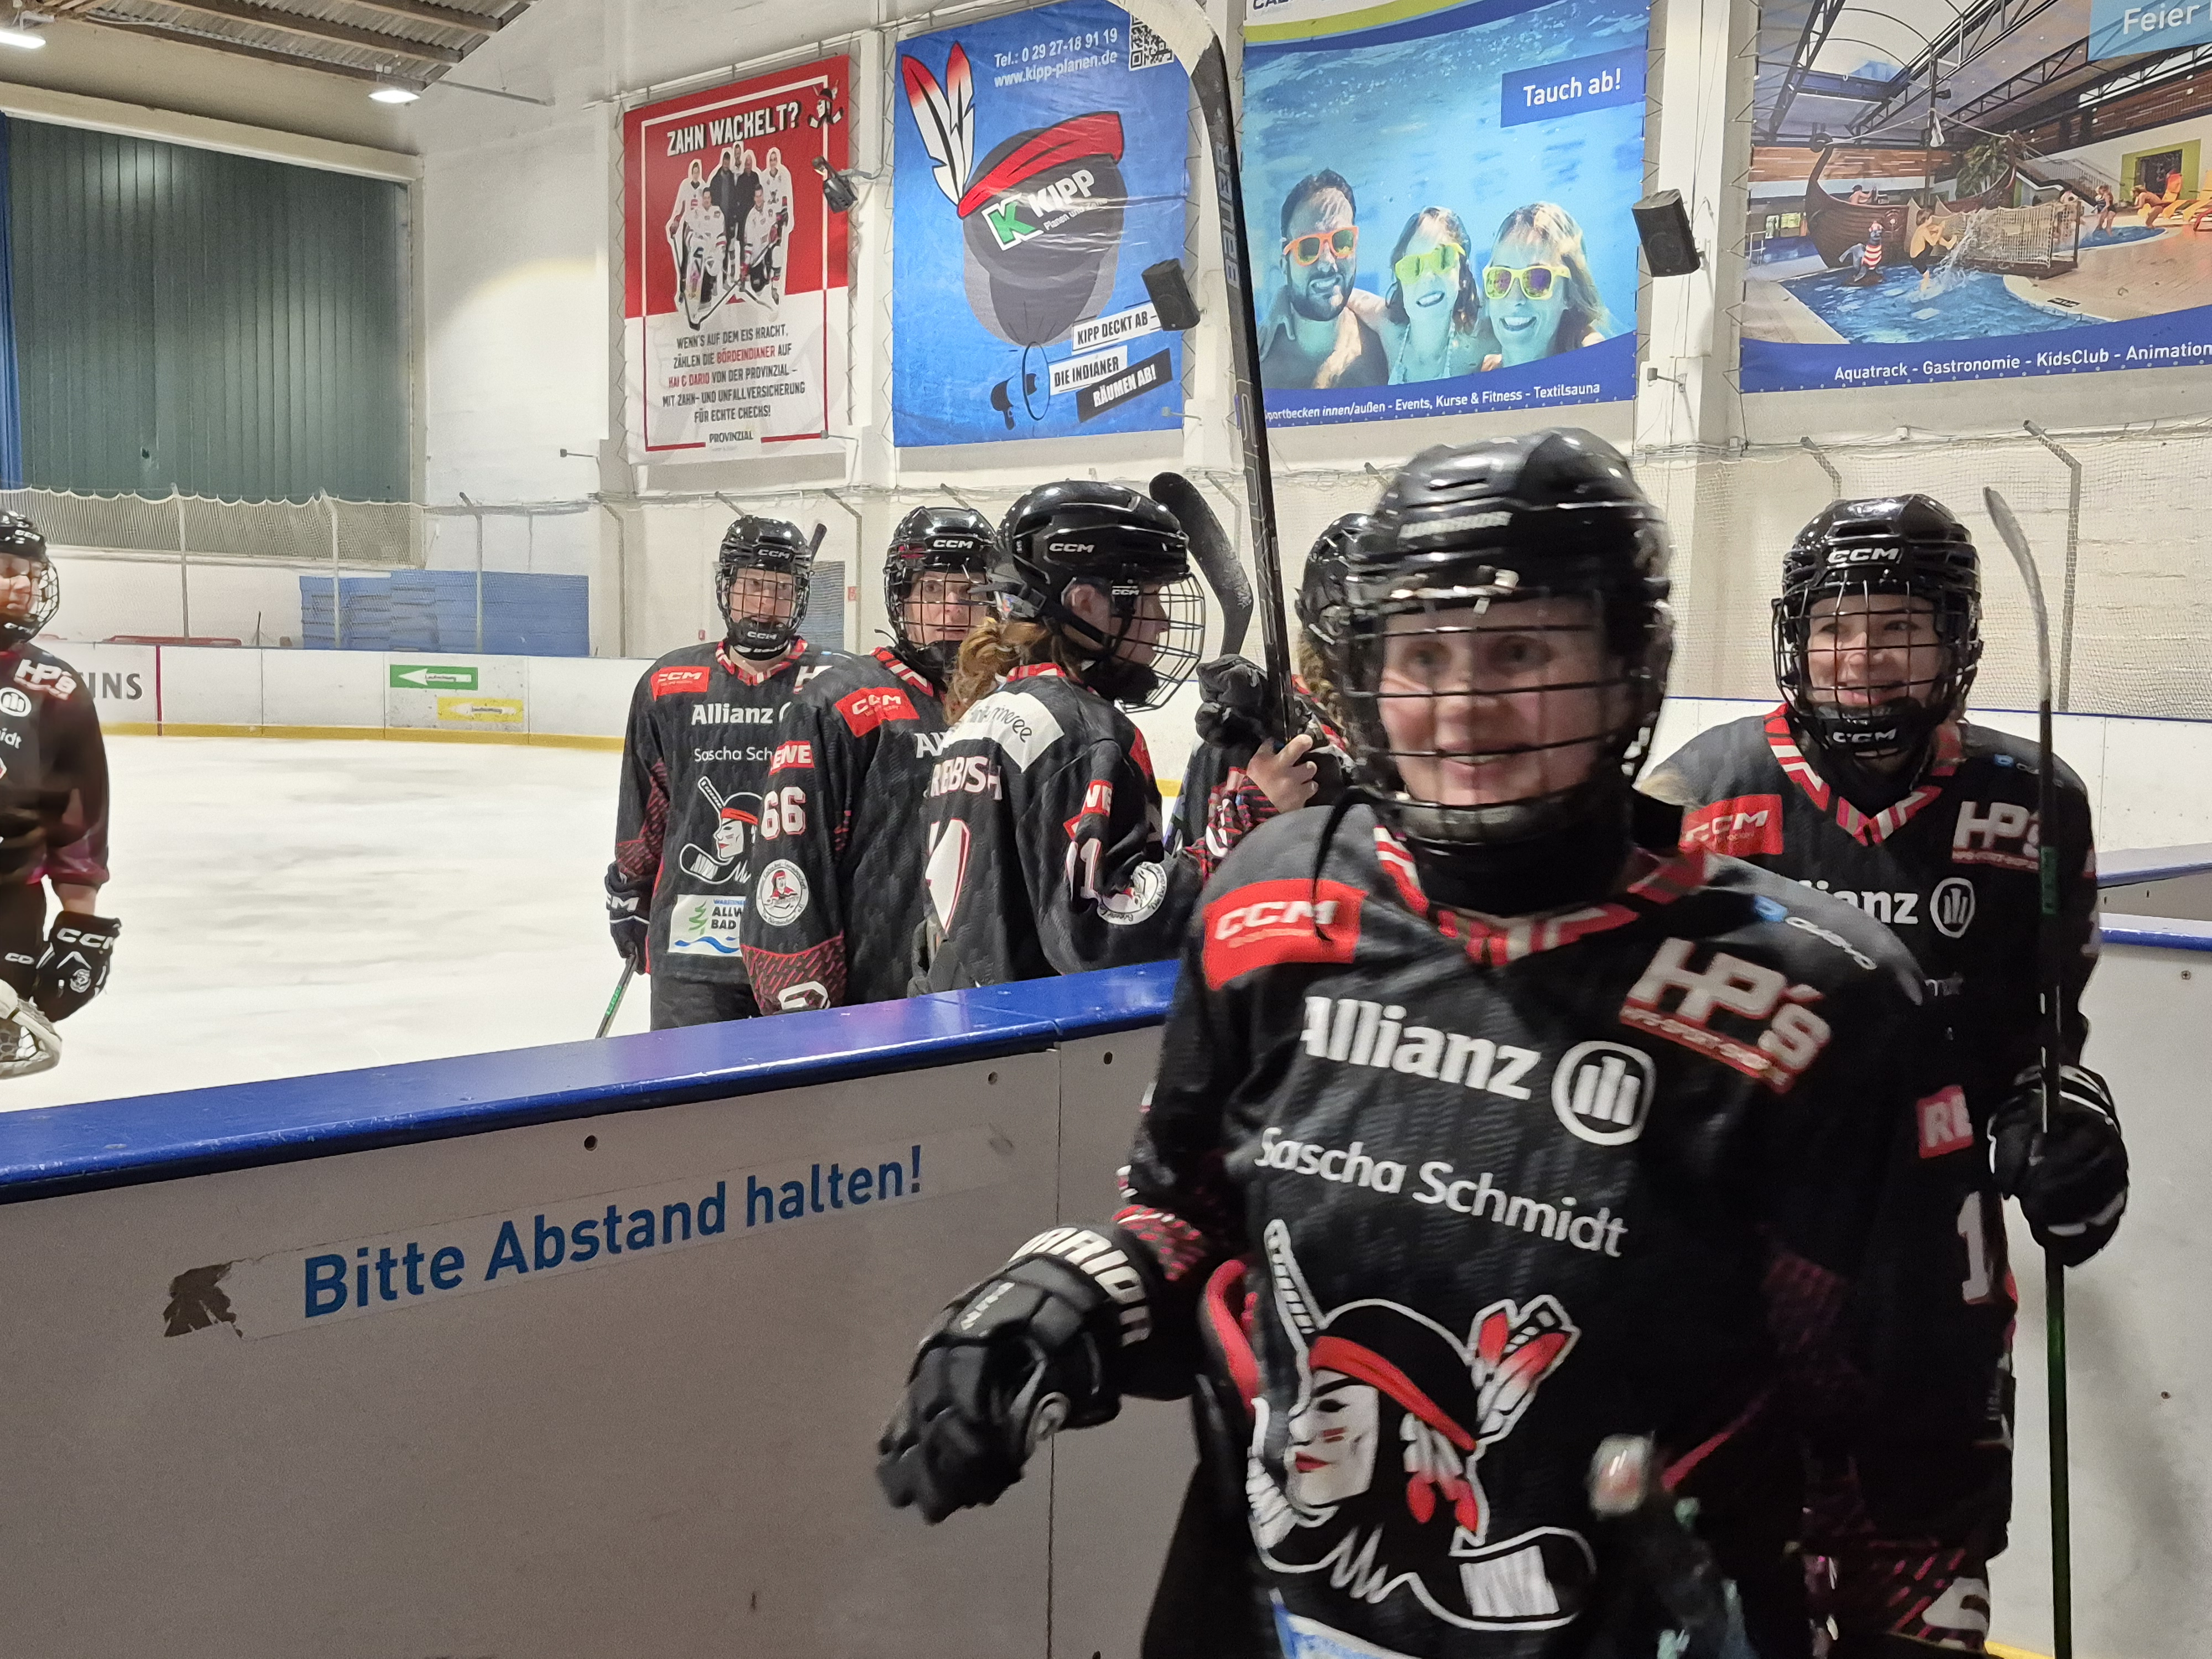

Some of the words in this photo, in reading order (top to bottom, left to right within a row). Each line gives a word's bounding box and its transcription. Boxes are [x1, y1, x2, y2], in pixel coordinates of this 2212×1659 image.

[2124, 3, 2200, 34] Feier
[994, 51, 1019, 67] Tel.:
[1021, 47, 1029, 62] 0
[1032, 43, 1046, 60] 29
[1050, 35, 1082, 56] 27-18
[1085, 31, 1099, 49] 91
[1103, 27, 1118, 44] 19
[994, 49, 1118, 87] www.kipp-planen.de
[1524, 76, 1583, 107] Tauch
[1588, 67, 1621, 94] ab!
[667, 124, 705, 156] ZAHN
[709, 101, 801, 146] WACKELT?
[1027, 169, 1094, 218] KIPP
[1043, 212, 1070, 231] Planen
[707, 333, 720, 346] AUF
[722, 330, 739, 344] DEM
[741, 328, 753, 341] EIS
[1077, 325, 1099, 345] KIPP
[1102, 315, 1133, 338] DECKT
[1135, 311, 1148, 328] AB
[674, 353, 700, 369] ZÄHLEN
[703, 353, 715, 366] DIE
[717, 345, 775, 364] BÖRDEINDIANER
[778, 343, 792, 356] AUF
[1834, 362, 1908, 383] Aquatrack
[1923, 354, 2021, 375] Gastronomie
[2037, 348, 2109, 367] KidsClub
[2126, 341, 2212, 361] Animation
[689, 372, 710, 386] DARIO
[712, 371, 726, 383] VON
[728, 368, 743, 382] DER
[745, 363, 790, 380] PROVINZIAL
[1054, 369, 1070, 387] DIE
[1072, 356, 1119, 382] INDIANER
[1093, 374, 1137, 408] RÄUMEN
[1137, 363, 1156, 387] AB!
[662, 394, 675, 407] MIT
[701, 390, 716, 404] UND
[718, 381, 805, 403] UNFALLVERSICHERUNG
[1322, 401, 1385, 416] innen/außen
[1395, 398, 1433, 411] Events,
[1436, 393, 1468, 408] Kurse
[1470, 392, 1479, 404] &
[1482, 388, 1522, 404] Fitness
[1533, 383, 1600, 399] Textilsauna
[694, 408, 709, 423] FÜR
[711, 408, 736, 421] ECHTE
[709, 430, 754, 443] PROVINZIAL
[758, 549, 790, 559] CCM
[933, 540, 973, 549] CCM
[1049, 542, 1095, 553] CCM
[1828, 547, 1900, 563] CCM
[691, 703, 773, 726] Allianz
[852, 695, 901, 715] CCM
[695, 747, 742, 763] Sascha
[760, 786, 806, 840] 66
[711, 919, 737, 930] BAD
[1214, 900, 1339, 940] CCM
[1254, 1127, 1406, 1193] Sascha
[1412, 1161, 1629, 1258] Schmidt
[305, 1243, 465, 1318] Bitte
[484, 1182, 725, 1281] Abstand
[747, 1145, 921, 1227] halten!
